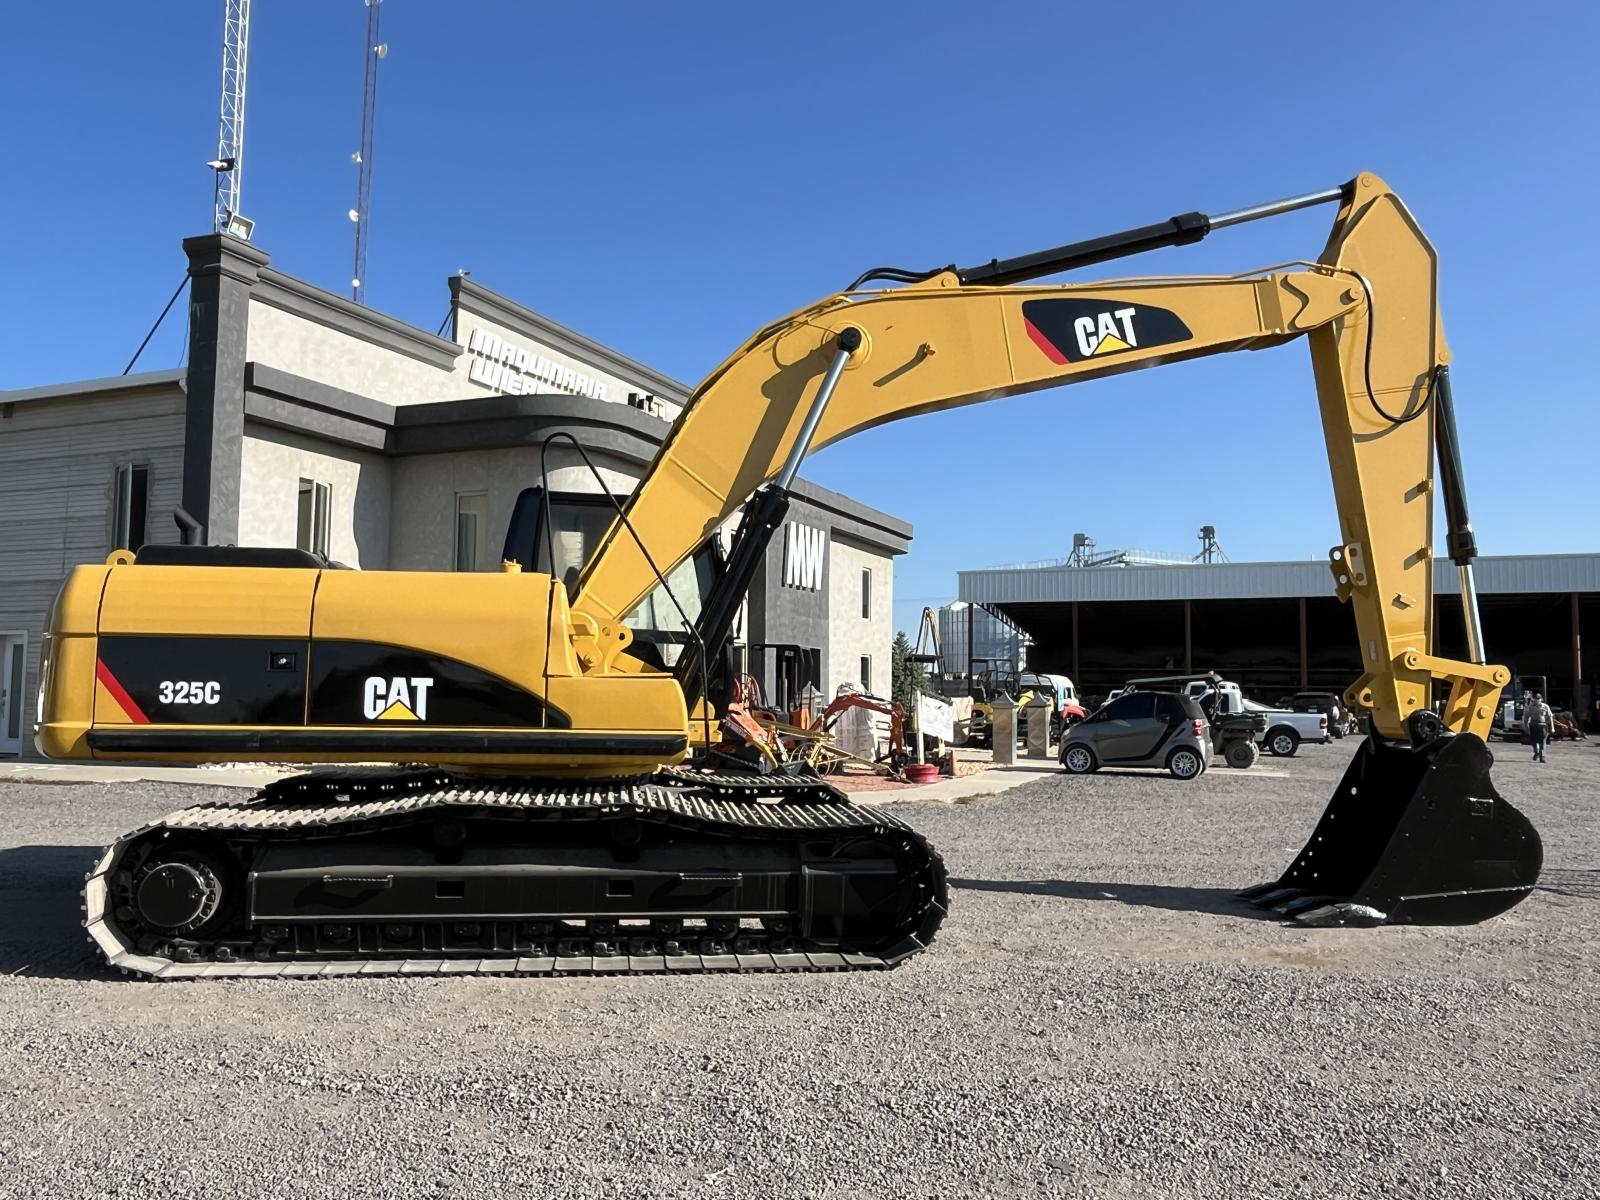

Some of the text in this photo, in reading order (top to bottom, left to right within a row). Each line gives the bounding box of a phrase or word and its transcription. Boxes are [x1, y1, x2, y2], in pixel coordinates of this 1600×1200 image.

[1074, 308, 1137, 356] CAT
[469, 328, 607, 400] MAQUINARIA
[787, 521, 825, 590] MW
[159, 681, 220, 704] 325C
[364, 676, 433, 720] CAT
